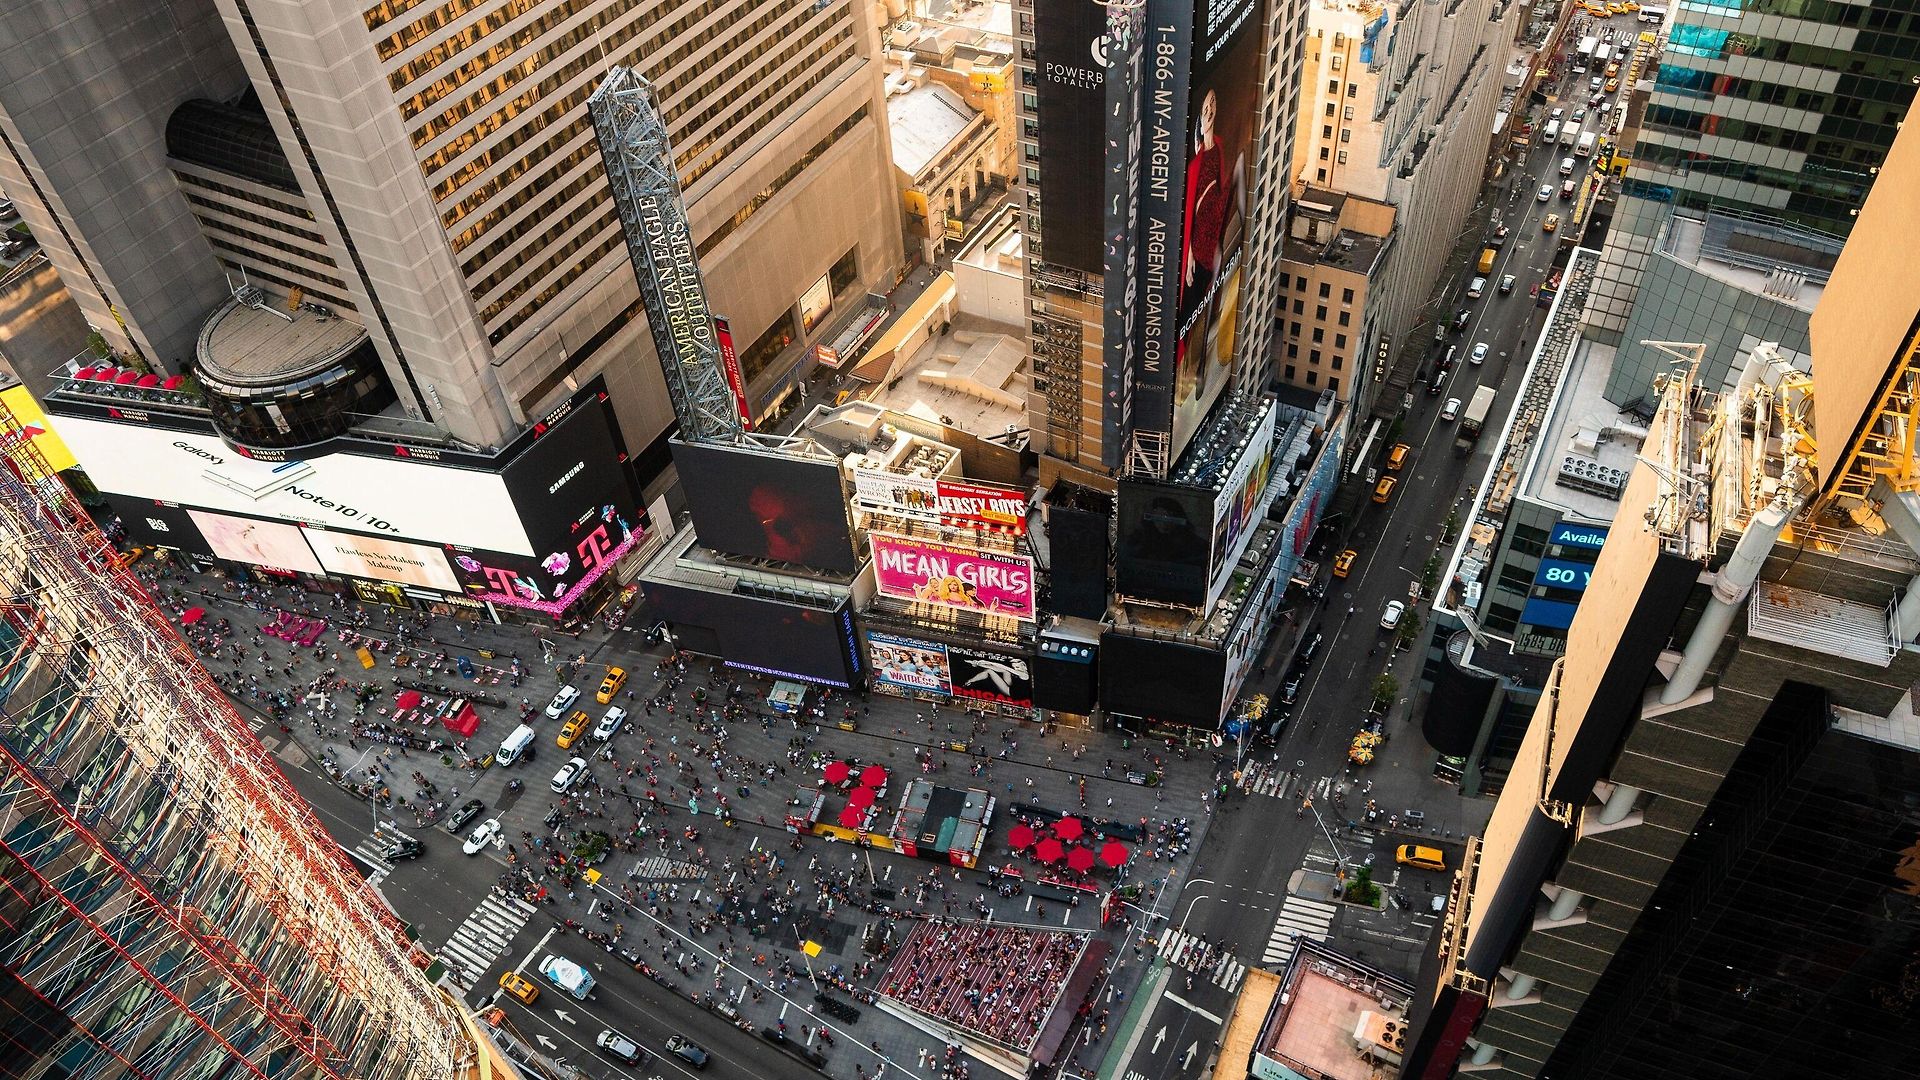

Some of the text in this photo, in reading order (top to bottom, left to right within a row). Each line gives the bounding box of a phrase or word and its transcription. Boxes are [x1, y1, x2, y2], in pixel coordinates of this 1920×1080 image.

[1208, 7, 1216, 23] BE
[1206, 46, 1214, 61] BE
[1215, 30, 1229, 52] YOUR
[1230, 15, 1241, 35] OWN
[1208, 20, 1216, 36] BE
[1046, 74, 1098, 90] TOTALLY
[1144, 24, 1176, 372] 1-866-MY-ARGENT ARGENTLOANS.COM
[1122, 44, 1144, 426] TIMES SQUARE
[638, 195, 697, 366] AMERICAN EAGLE
[667, 221, 710, 339] OUTFITTERS
[1374, 342, 1388, 382] HOTEL
[123, 414, 149, 422] MARQUIS
[546, 398, 572, 421] MARRIOTT
[548, 405, 572, 426] MARQUIS
[172, 441, 225, 465] Galaxy
[409, 448, 440, 456] MARRIOTT
[549, 461, 585, 494] SAMSUNG
[949, 485, 976, 493] BROADWAY
[976, 489, 1002, 497] SENSATION
[939, 496, 1026, 517] JERSEY BOYS
[366, 517, 400, 533] 10+
[1559, 530, 1605, 546] Availa
[334, 546, 373, 559] Flawless
[875, 535, 1027, 567] YOU KNOW YOU WANNA SIT WITH US
[366, 559, 403, 573] Makeup
[881, 550, 1028, 595] MEAN GIRLS
[1546, 567, 1575, 583] 80
[889, 671, 935, 687] WAITRESS
